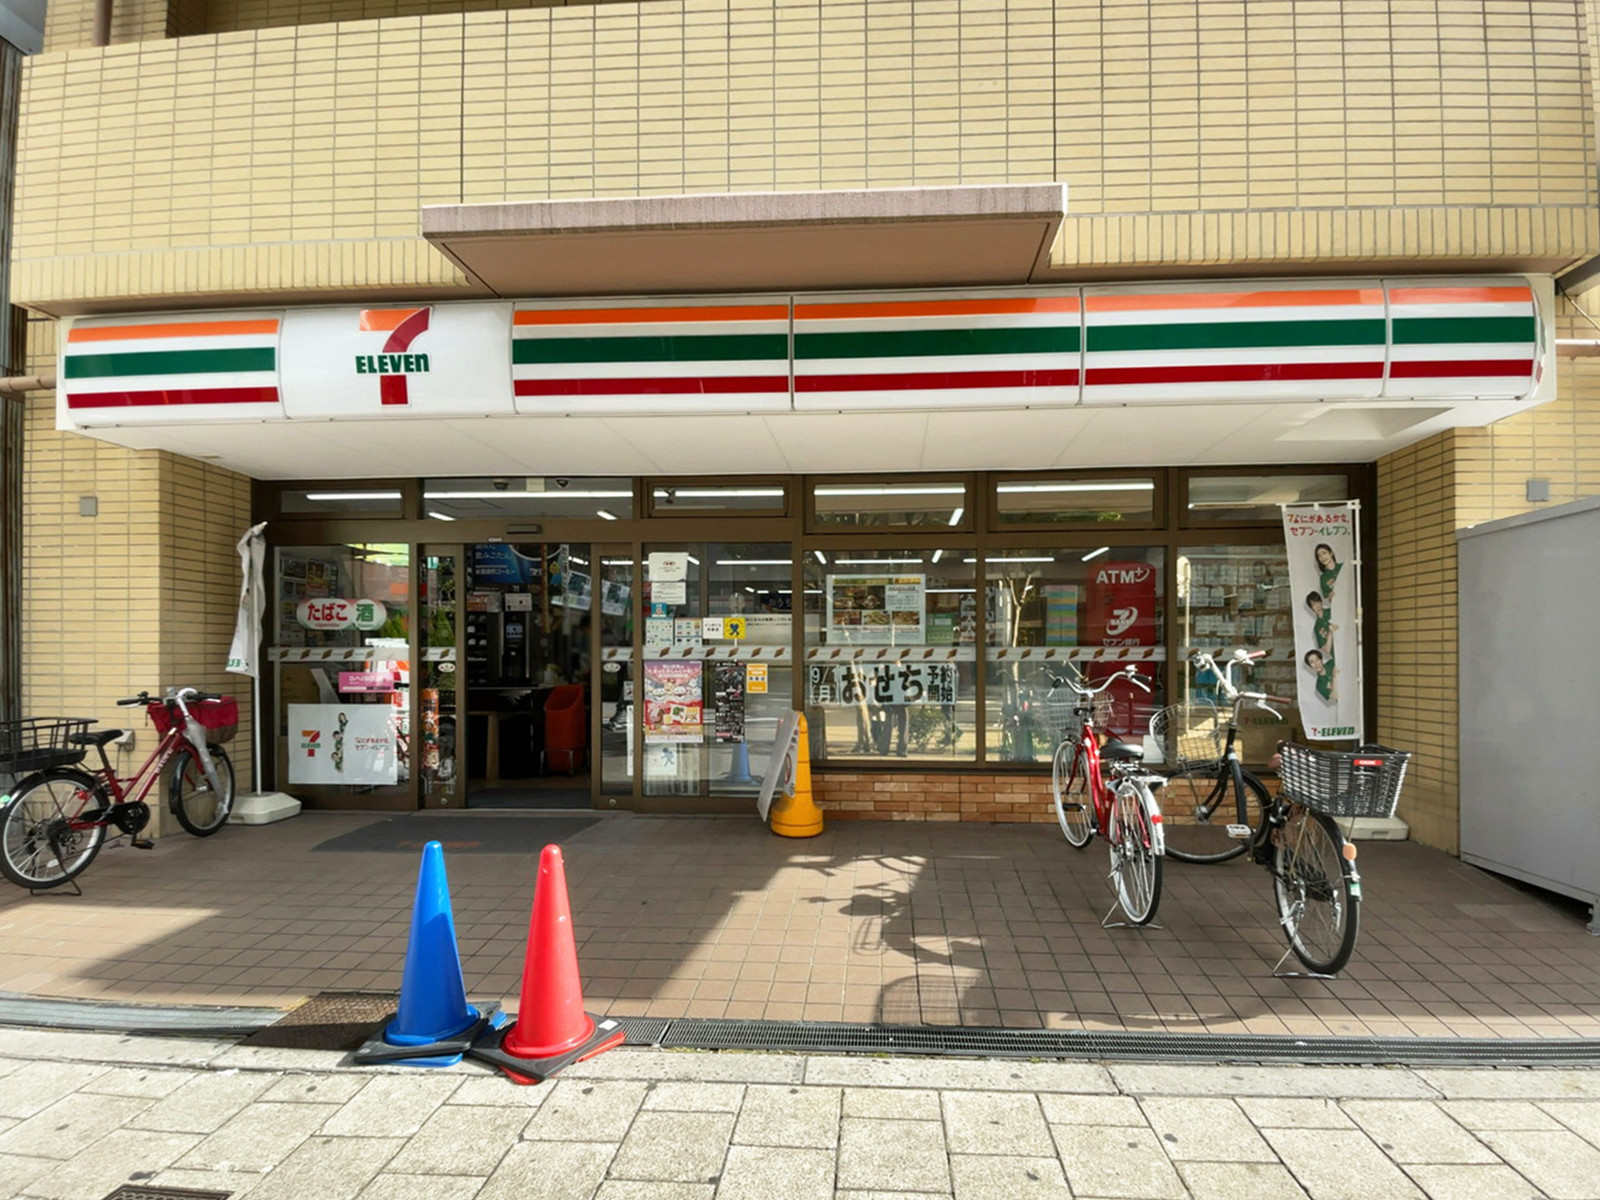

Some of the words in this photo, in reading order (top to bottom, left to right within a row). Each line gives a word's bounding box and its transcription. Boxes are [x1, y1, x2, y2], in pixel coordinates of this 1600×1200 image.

[307, 602, 348, 622] たばこ
[356, 602, 374, 622] 酒
[841, 664, 924, 704] おせち
[927, 664, 953, 684] 予約
[928, 684, 953, 702] 開始
